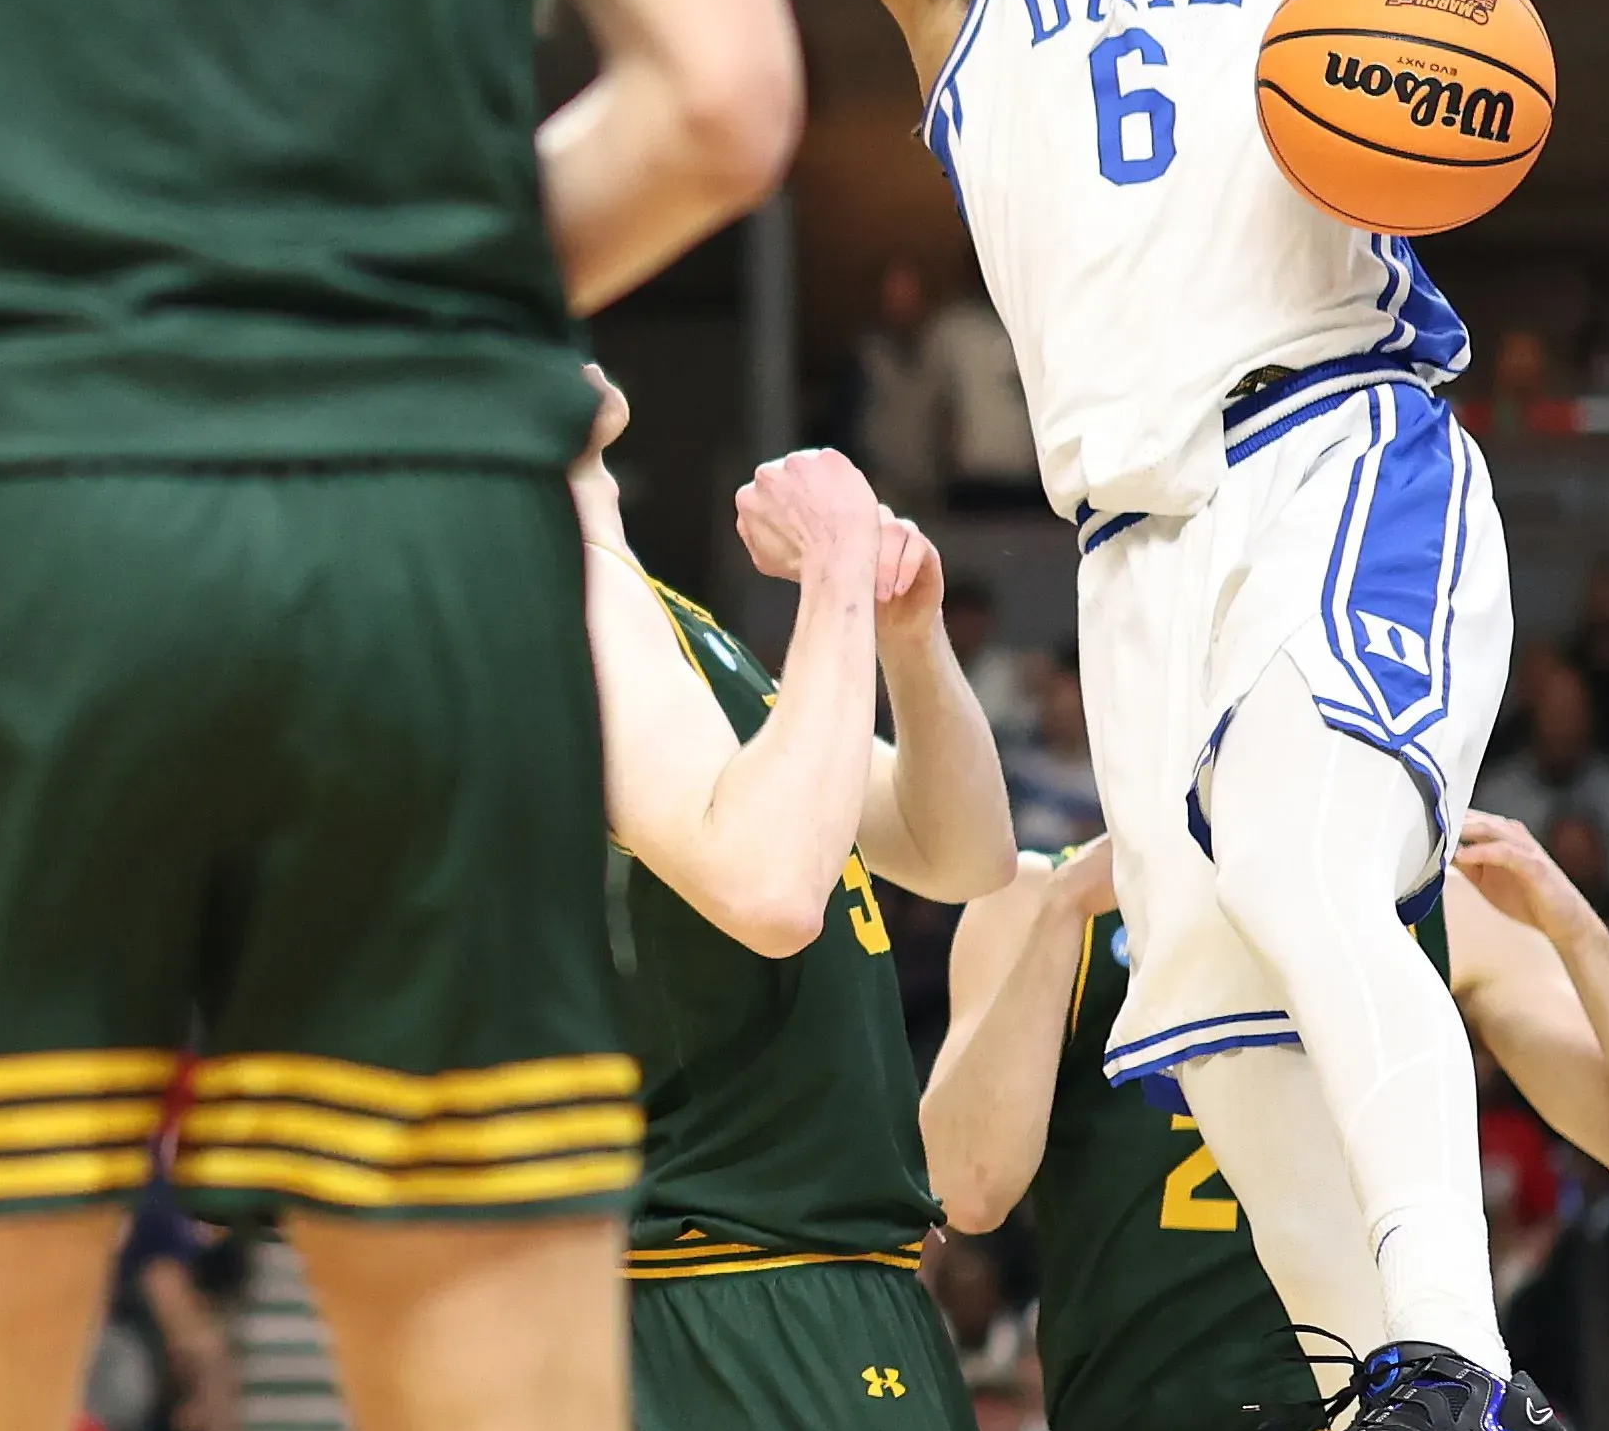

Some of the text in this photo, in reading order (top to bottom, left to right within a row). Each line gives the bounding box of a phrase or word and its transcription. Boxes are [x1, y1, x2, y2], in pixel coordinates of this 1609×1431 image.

[1089, 27, 1178, 187] 6
[1325, 50, 1515, 145] Wilson
[1395, 55, 1458, 77] EVO NXT
